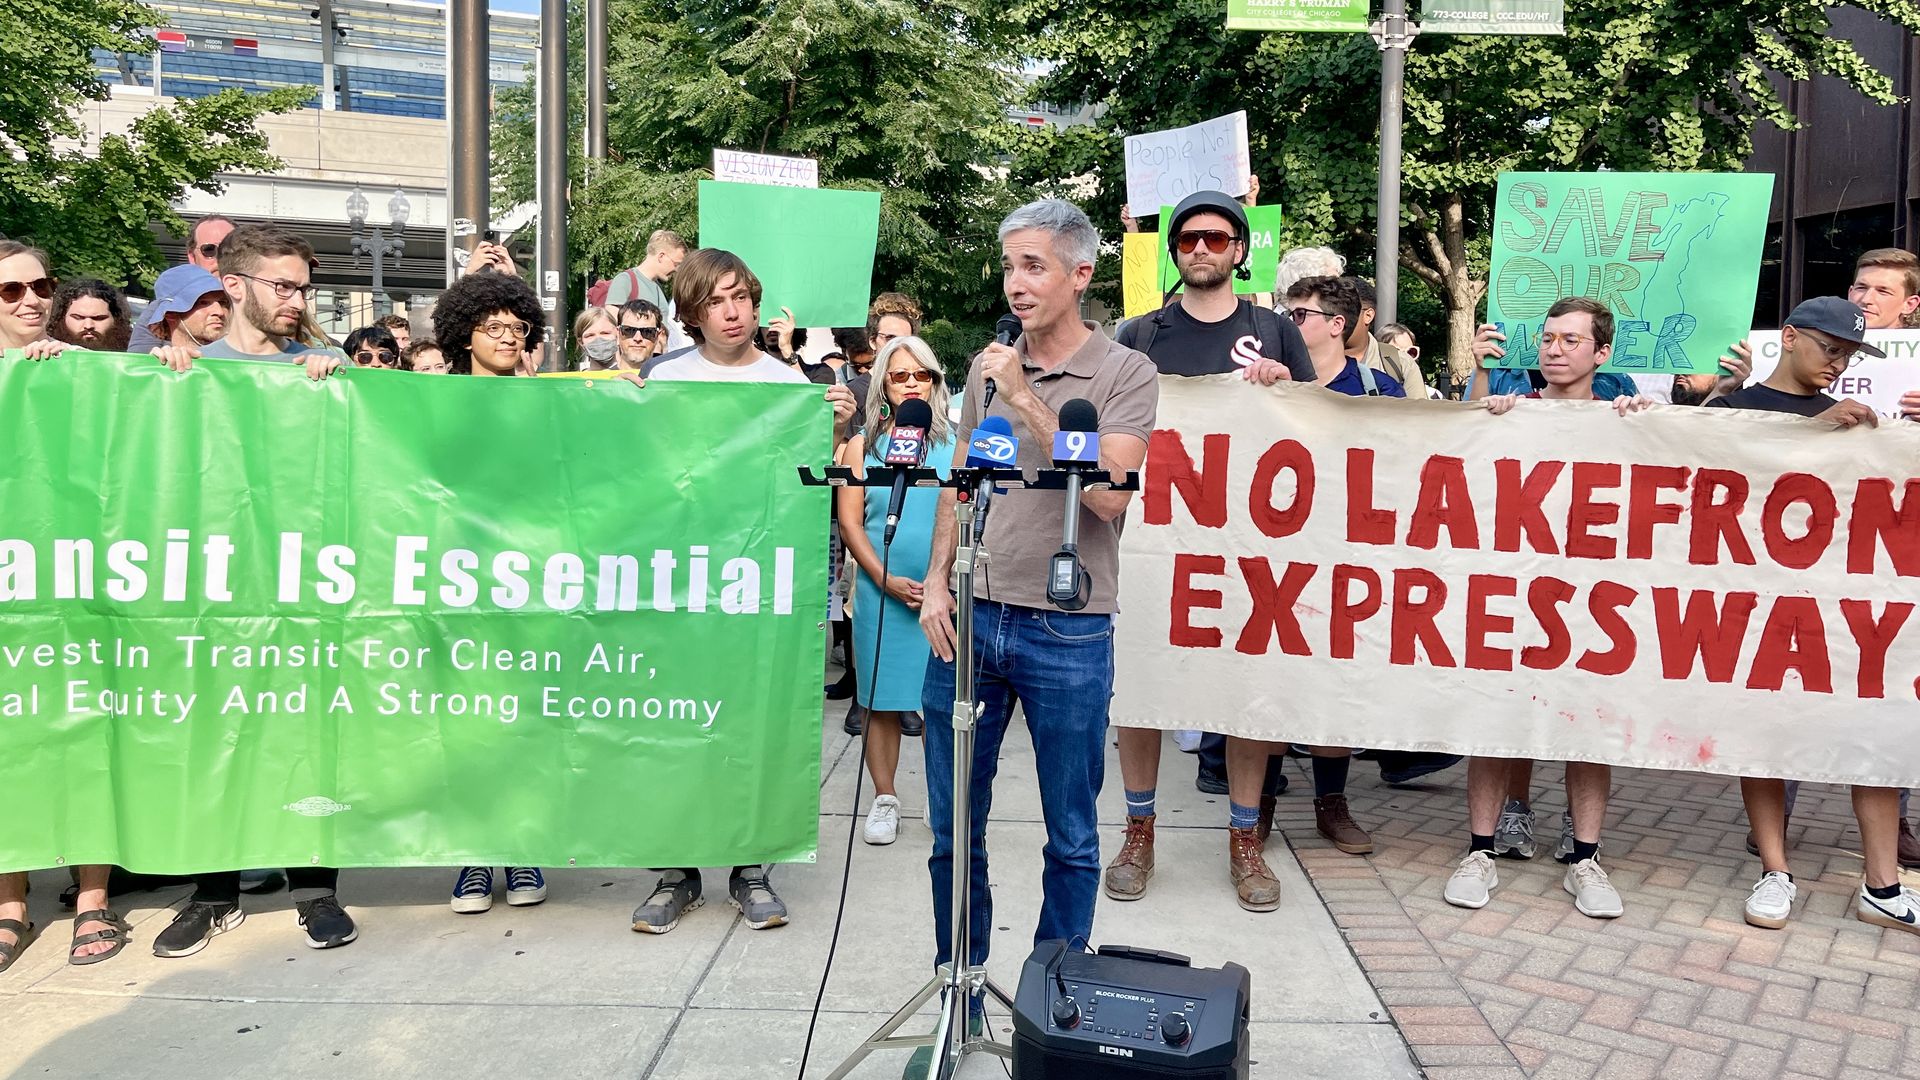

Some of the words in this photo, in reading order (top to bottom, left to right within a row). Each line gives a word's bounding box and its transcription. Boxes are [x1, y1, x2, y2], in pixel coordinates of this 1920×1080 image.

[1299, 0, 1350, 8] TRUMAN
[1433, 10, 1489, 20] 773-COLLEGE
[1496, 12, 1550, 21] CCC.EDU/HT
[1130, 133, 1193, 171] People
[1201, 122, 1232, 154] Not
[719, 152, 775, 177] VISION
[779, 158, 814, 181] ZERO
[1156, 164, 1222, 203] Cars
[1500, 182, 1668, 261] SAVE
[1251, 230, 1274, 249] RA
[1126, 241, 1148, 273] NO
[1127, 278, 1151, 305] ON
[1497, 256, 1641, 319] OUR
[1495, 314, 1696, 369] WER
[1827, 377, 1872, 394] VER
[890, 439, 918, 456] 32
[895, 429, 920, 438] FOX
[1066, 431, 1087, 460] 9
[1141, 429, 1315, 538] NO
[1345, 448, 1920, 577] LAKEFRON
[0, 529, 235, 602] ansit
[278, 532, 357, 604] Is
[392, 535, 795, 615] Essential
[3, 637, 104, 668] vest
[116, 638, 150, 669] In
[176, 636, 340, 669] Transit
[363, 640, 431, 669] For
[451, 639, 562, 672] Clean
[583, 642, 657, 680] Air,
[2, 684, 39, 717] al
[67, 680, 197, 724] Equity
[220, 684, 307, 715] And
[328, 685, 354, 714] A
[377, 682, 520, 724] Strong
[541, 686, 722, 728] Economy
[1095, 990, 1115, 999] BLOCK
[1116, 992, 1139, 1002] ROCKER
[1140, 995, 1155, 1004] PLUS
[1099, 1046, 1133, 1058] ION
